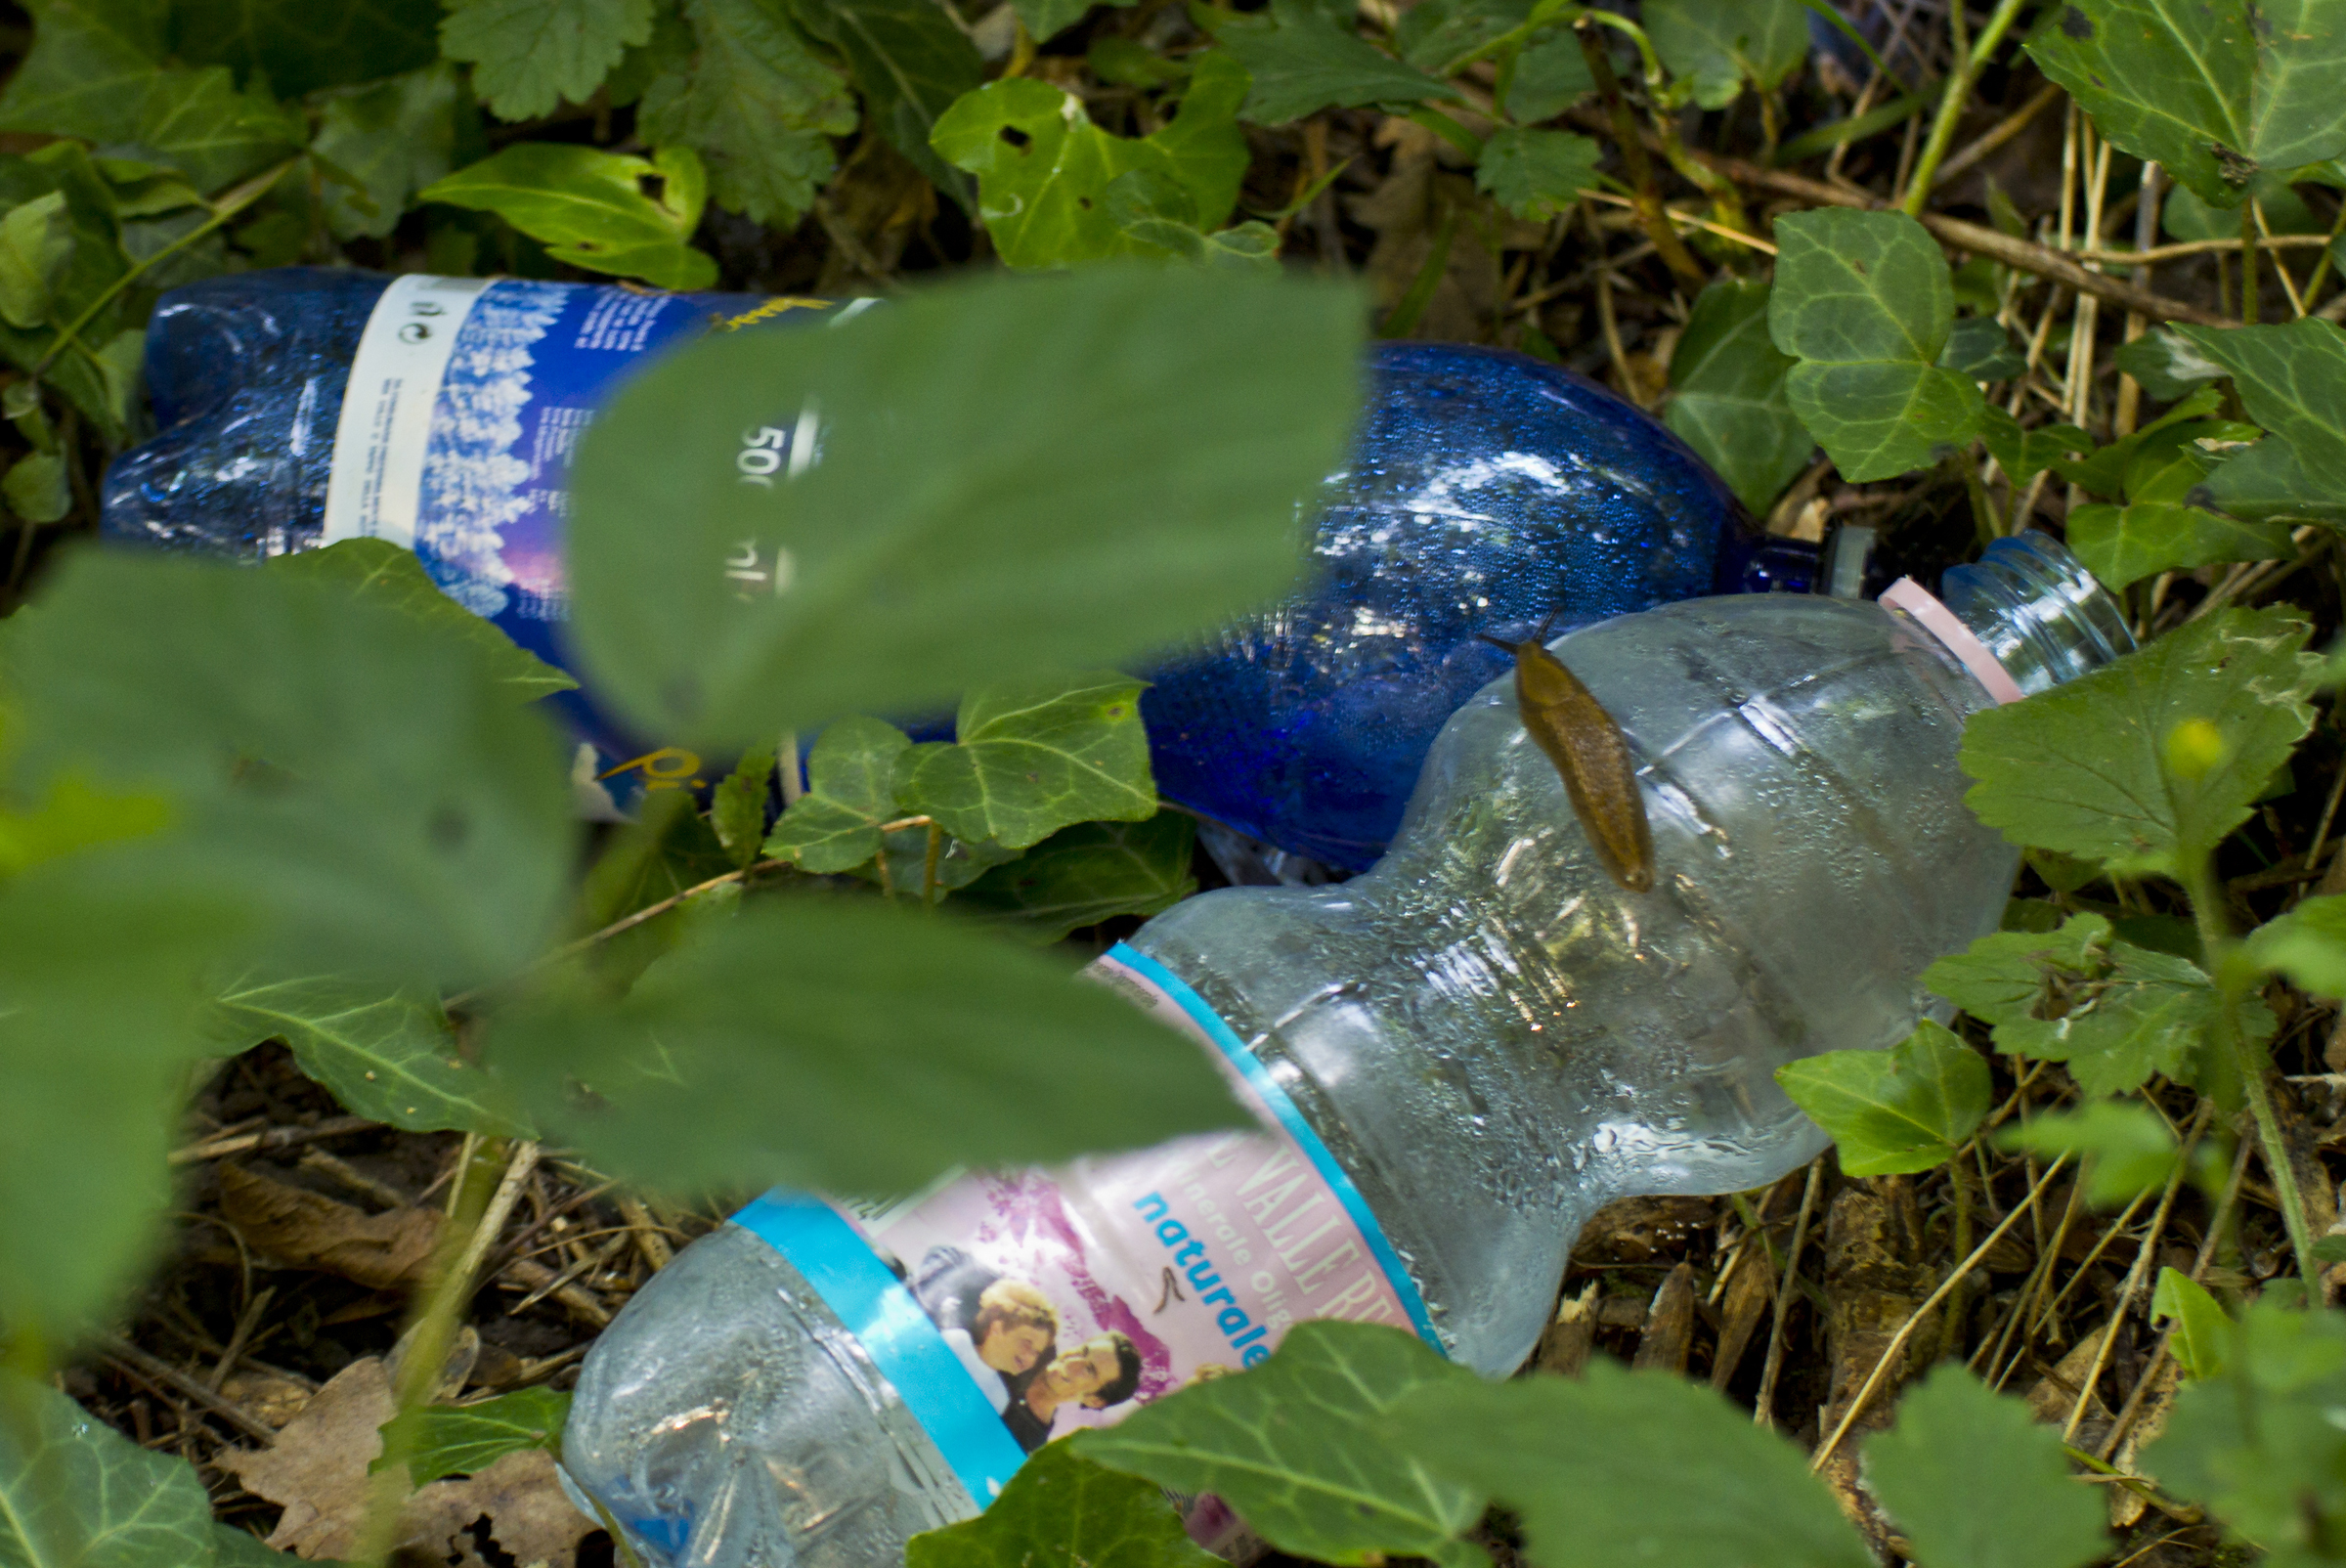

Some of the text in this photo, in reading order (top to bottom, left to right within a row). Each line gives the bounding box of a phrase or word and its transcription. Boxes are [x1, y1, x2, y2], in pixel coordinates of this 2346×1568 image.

[1132, 1191, 1271, 1369] naturale
[1161, 1149, 1252, 1267] Minerale
[1250, 1270, 1299, 1330] Olig
[1236, 1143, 1361, 1295] VALLE
